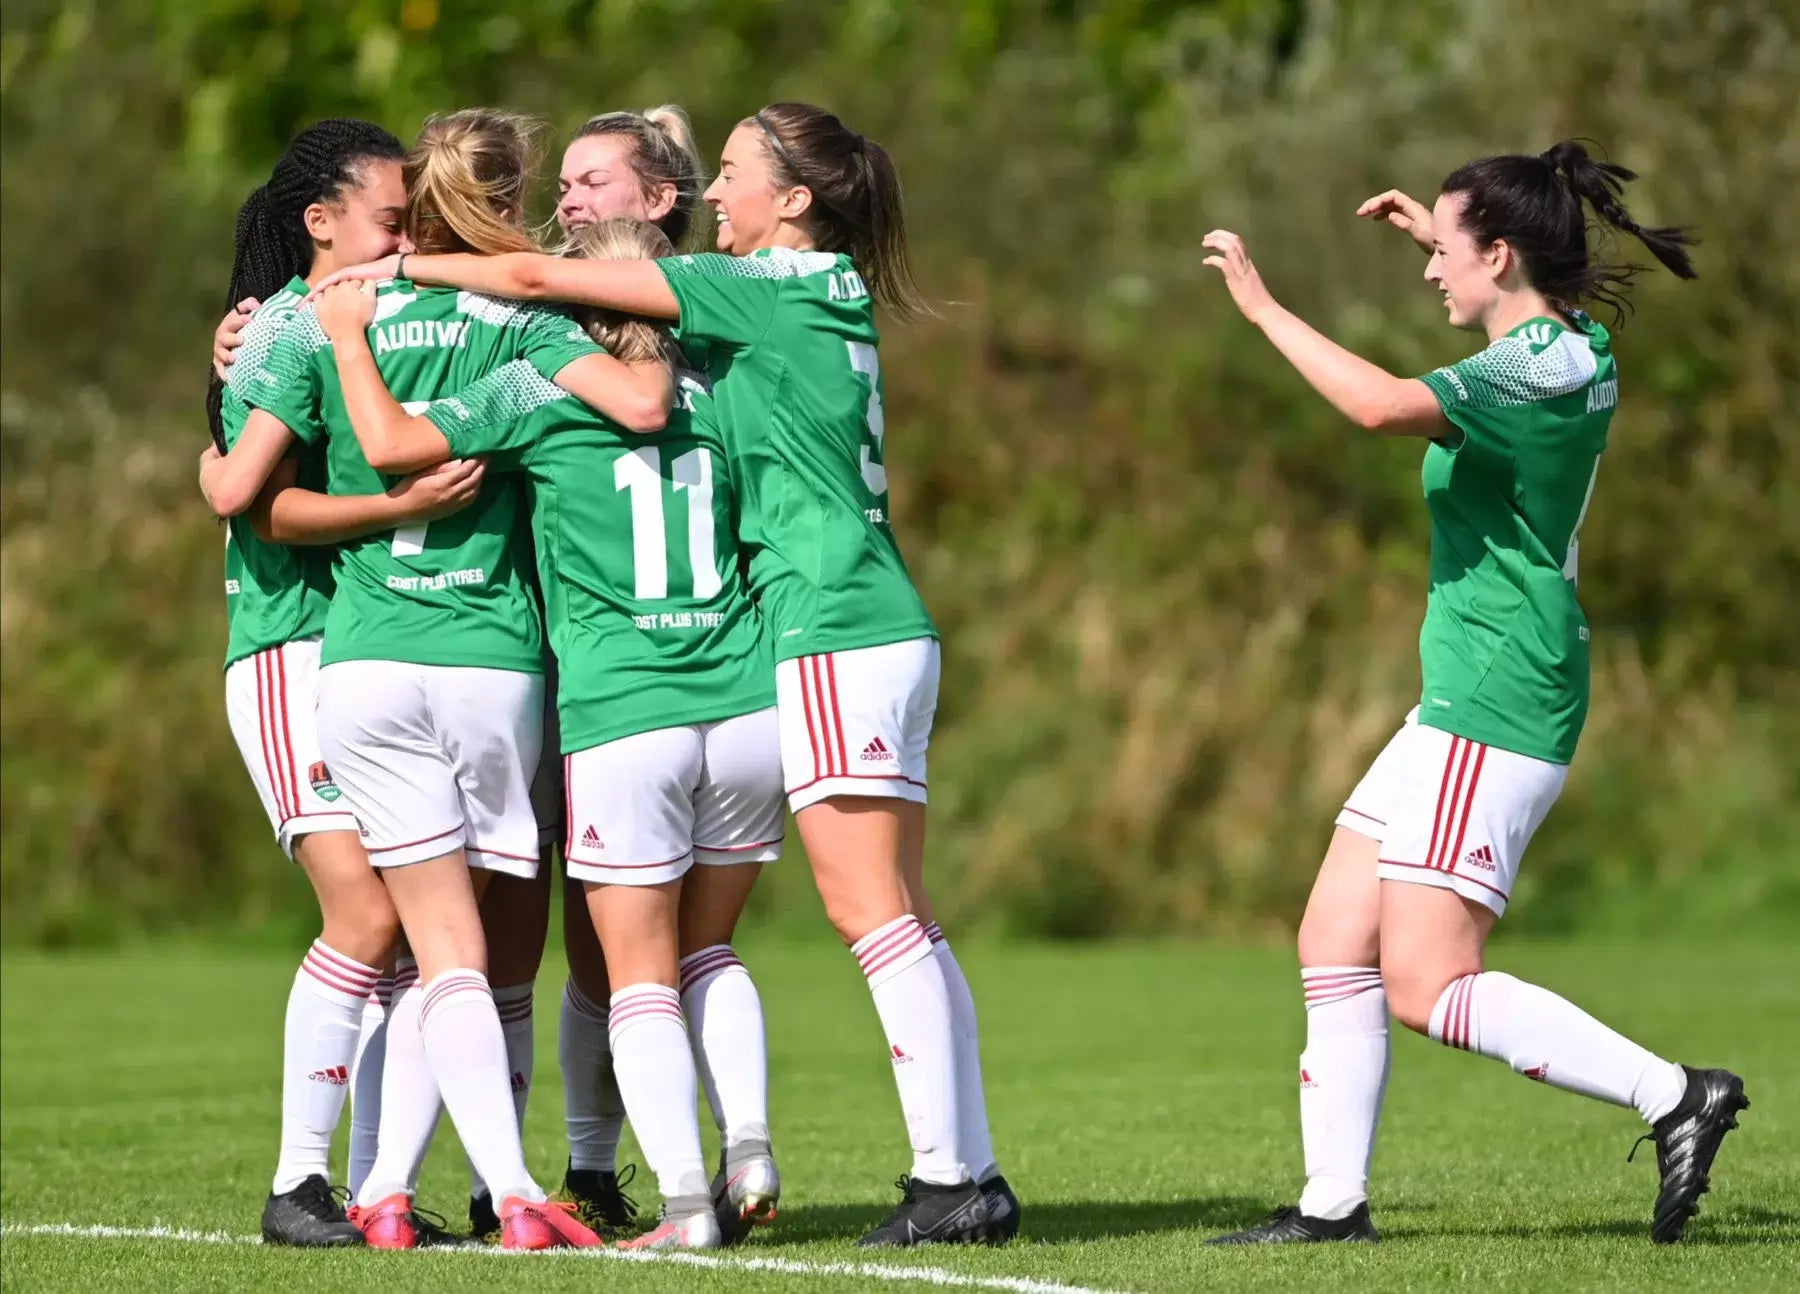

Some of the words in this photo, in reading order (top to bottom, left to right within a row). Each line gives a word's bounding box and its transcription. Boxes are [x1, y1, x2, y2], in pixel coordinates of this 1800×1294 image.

[613, 446, 723, 600] 11
[445, 567, 484, 587] TYRES
[660, 612, 692, 629] PLUS
[860, 751, 894, 761] adidas
[1464, 855, 1496, 872] adidas
